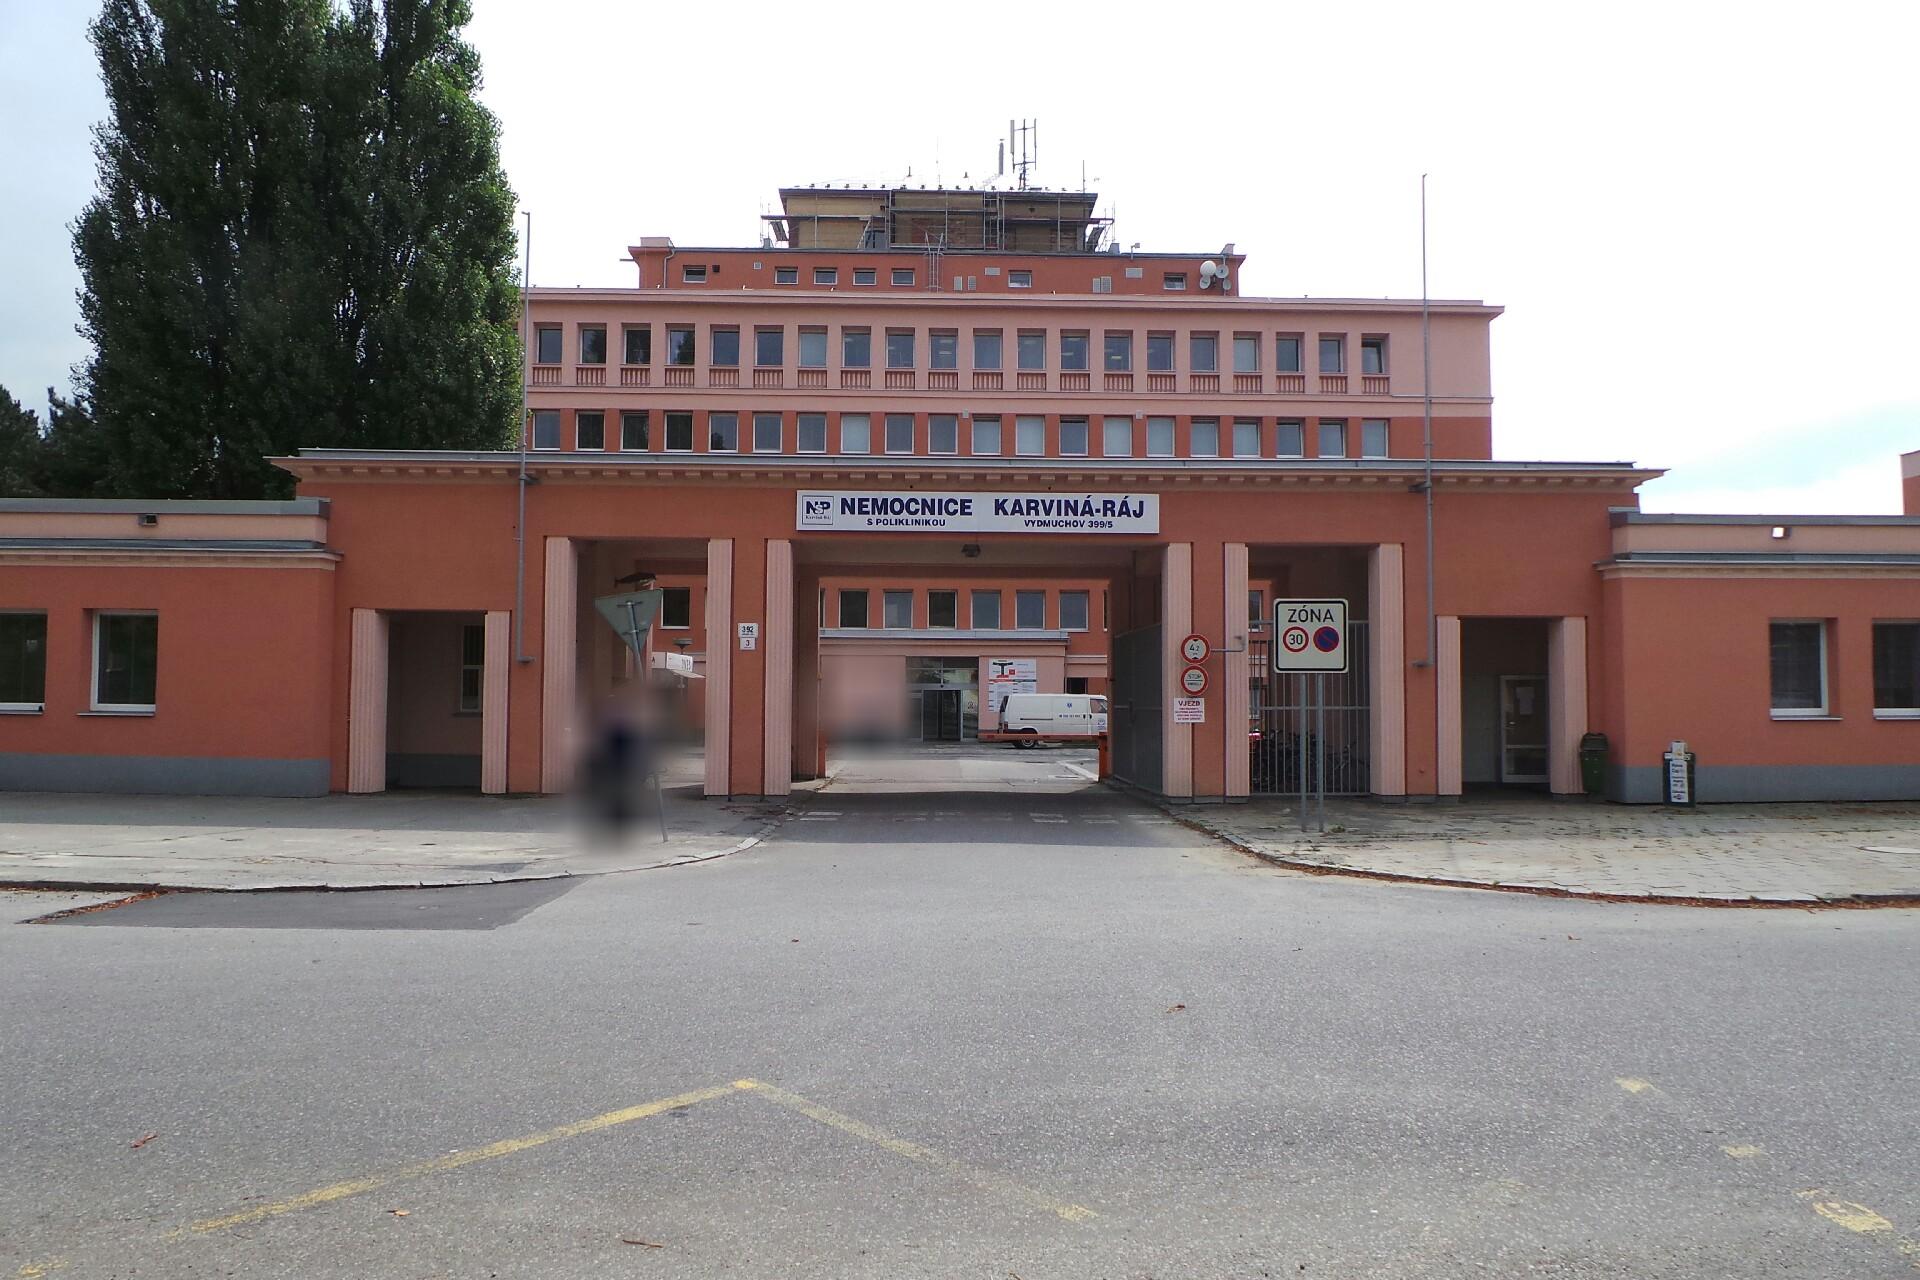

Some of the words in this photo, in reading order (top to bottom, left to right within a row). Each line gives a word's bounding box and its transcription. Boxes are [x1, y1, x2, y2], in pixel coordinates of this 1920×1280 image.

[806, 500, 831, 515] NSP
[840, 497, 973, 517] NEMOCNICE
[994, 495, 1145, 519] KARVINÁ-RÁJ
[867, 518, 873, 526] S
[876, 518, 946, 527] POLIKLINIKOU
[1024, 519, 1086, 528] VYDMUCHOV
[1088, 520, 1114, 529] 399/5
[1288, 604, 1334, 622] ZÓNA
[1288, 633, 1303, 645] 30
